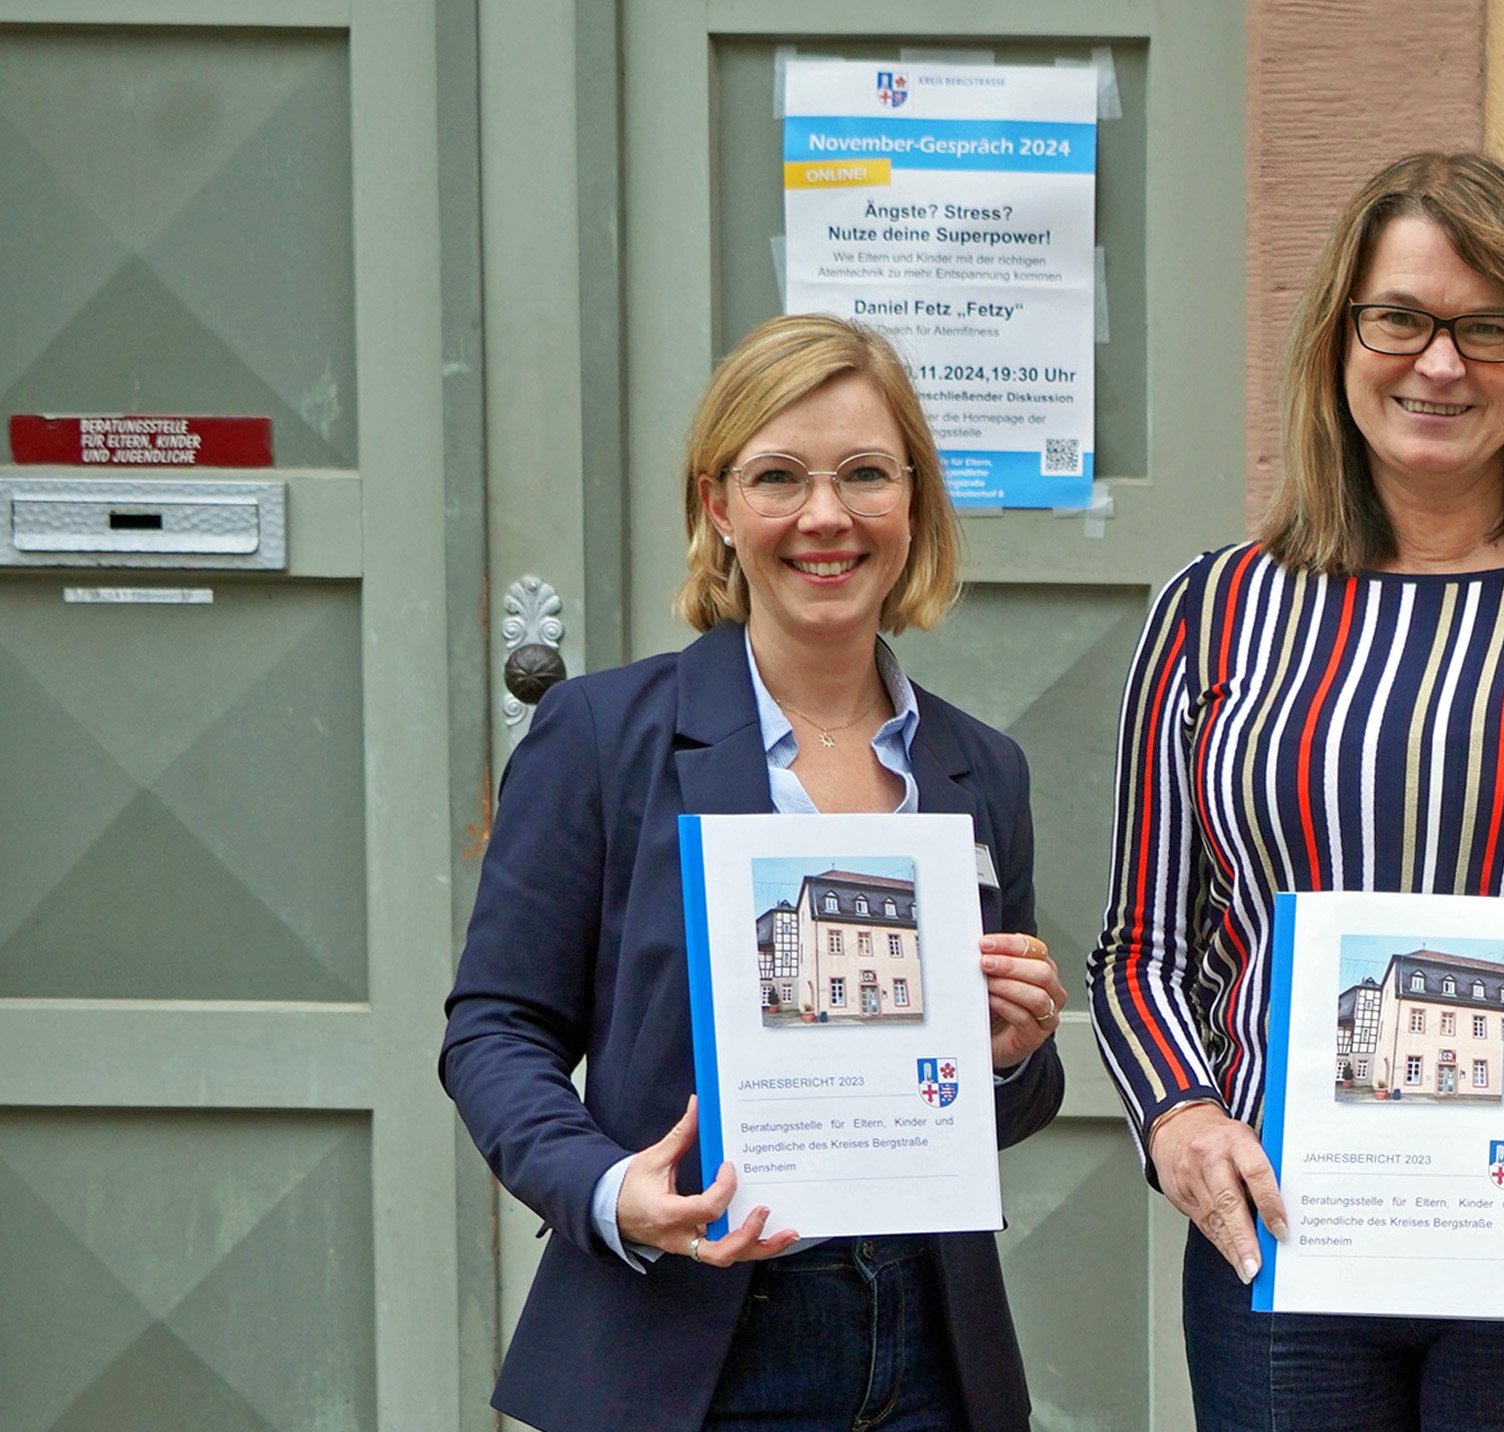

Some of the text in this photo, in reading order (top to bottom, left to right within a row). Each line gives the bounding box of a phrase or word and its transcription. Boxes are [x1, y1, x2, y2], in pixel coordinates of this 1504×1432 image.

[809, 133, 1071, 159] November-Gespräch 2024
[805, 169, 867, 183] ONLINE!
[865, 199, 1013, 223] Ängste? Stress?
[828, 226, 1051, 248] Nutze deine Superpower!
[833, 252, 1046, 268] Wie Eltern und Kinder mit der richtigen
[817, 267, 1062, 283] Atemtechnik zu mehr Entspannung kommen
[854, 300, 908, 315] Daniel
[914, 301, 951, 316] Fetz
[916, 326, 931, 336] für
[933, 326, 1000, 337] Atemfitness
[1044, 368, 1077, 382] Uhr
[918, 391, 1074, 403] nschließender Diskussion
[80, 419, 190, 434] BERATUNGSSTELLE
[942, 413, 959, 422] die
[963, 413, 1024, 425] Homepage
[1027, 414, 1046, 423] der
[81, 433, 202, 449] FÜR ELTERN, KINDER
[81, 448, 197, 463] UND JUGENDLICHE
[738, 1076, 865, 1090] JAHRESBERICHT 2023
[740, 1121, 823, 1134] Beratungsstelle
[831, 1119, 845, 1129] für
[894, 1117, 927, 1127] Kinder
[935, 1116, 954, 1126] und
[742, 1136, 929, 1155] Jugendliche des Kreises Bergstraße
[1303, 1153, 1432, 1165] JAHRESBERICHT 2023
[743, 1161, 797, 1173] Bensheim
[1301, 1195, 1384, 1208] Beratungsstelle
[1392, 1196, 1407, 1207] für
[1458, 1198, 1494, 1208] Kinder
[1299, 1215, 1493, 1230] Jugendliche des Kreises Bergstraße
[1299, 1235, 1353, 1246] Bensheim
